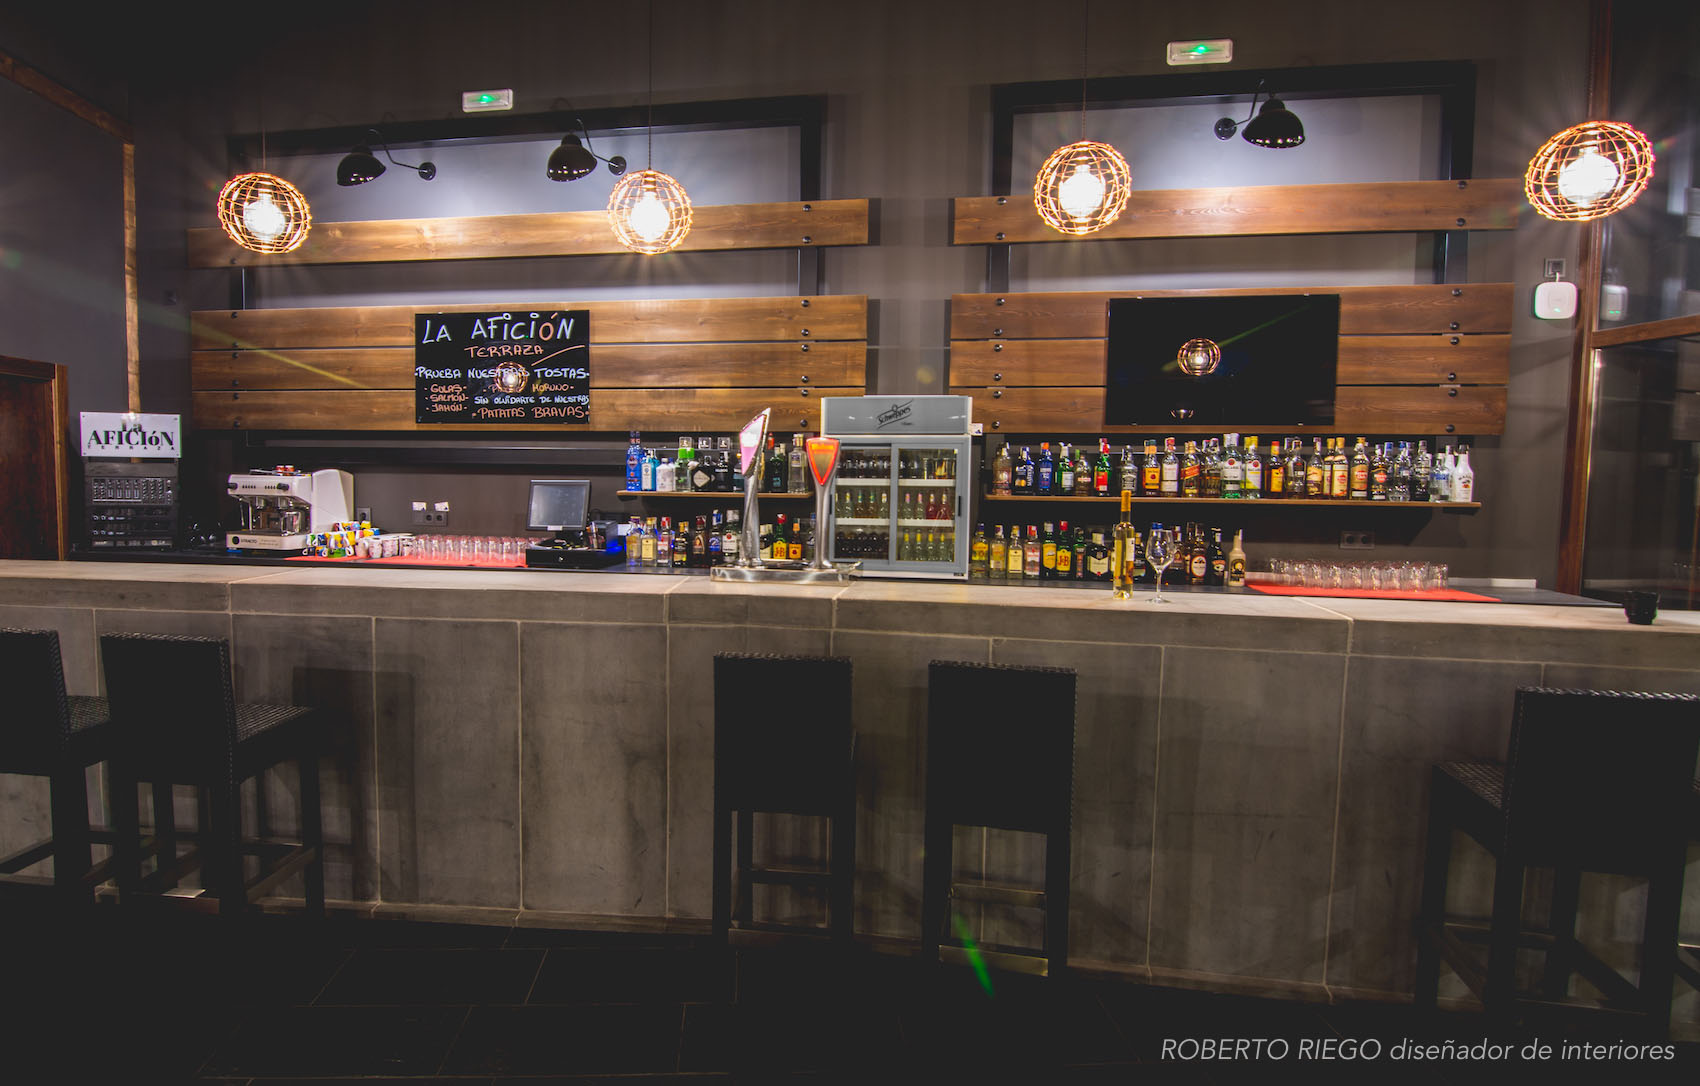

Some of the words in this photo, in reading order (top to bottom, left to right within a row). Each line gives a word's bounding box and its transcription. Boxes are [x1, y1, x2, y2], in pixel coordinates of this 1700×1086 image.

[422, 319, 452, 344] LA
[464, 345, 544, 358] TERRAZA
[416, 366, 462, 379] PRUEBA
[477, 407, 525, 419] PATATAS
[531, 406, 585, 419] BRAVAS
